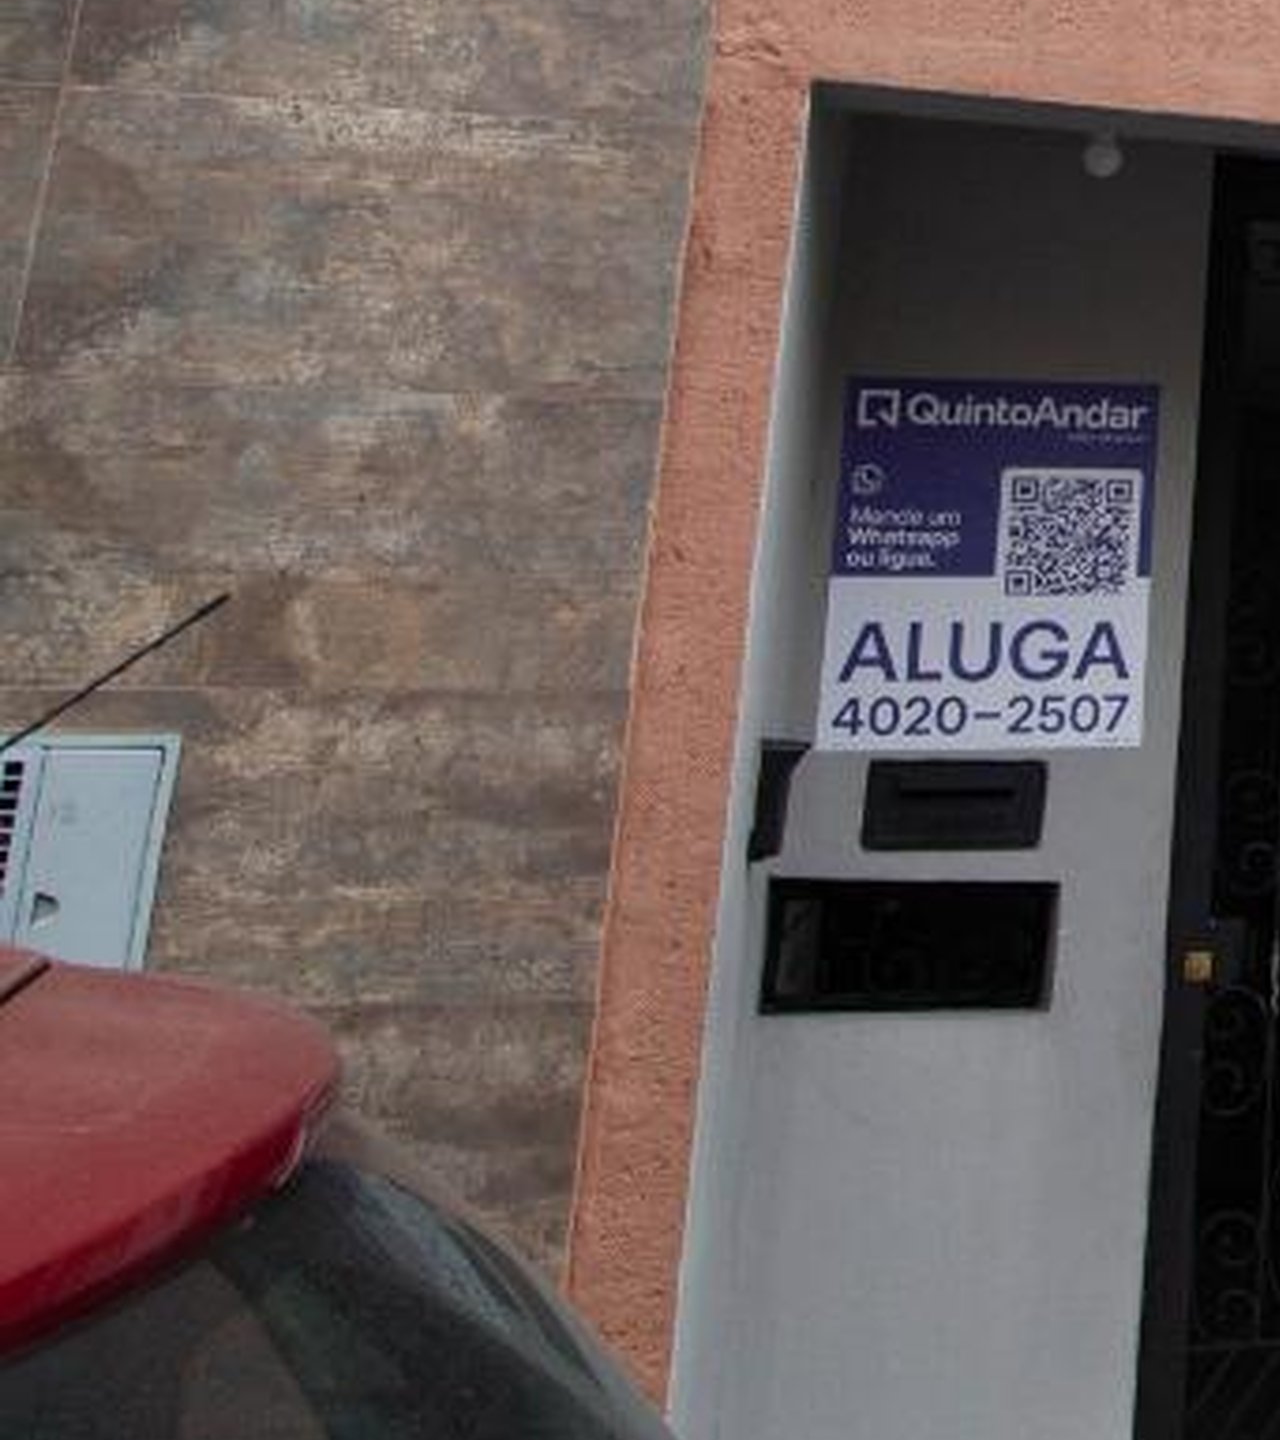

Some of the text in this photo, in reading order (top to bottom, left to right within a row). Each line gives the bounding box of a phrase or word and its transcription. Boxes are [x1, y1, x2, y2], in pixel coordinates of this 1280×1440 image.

[907, 393, 1149, 430] QuintoAndar
[848, 505, 961, 526] Mande um
[845, 551, 875, 567] ou
[838, 621, 1130, 683] ALUGA
[831, 694, 1131, 737] 4020-2507
